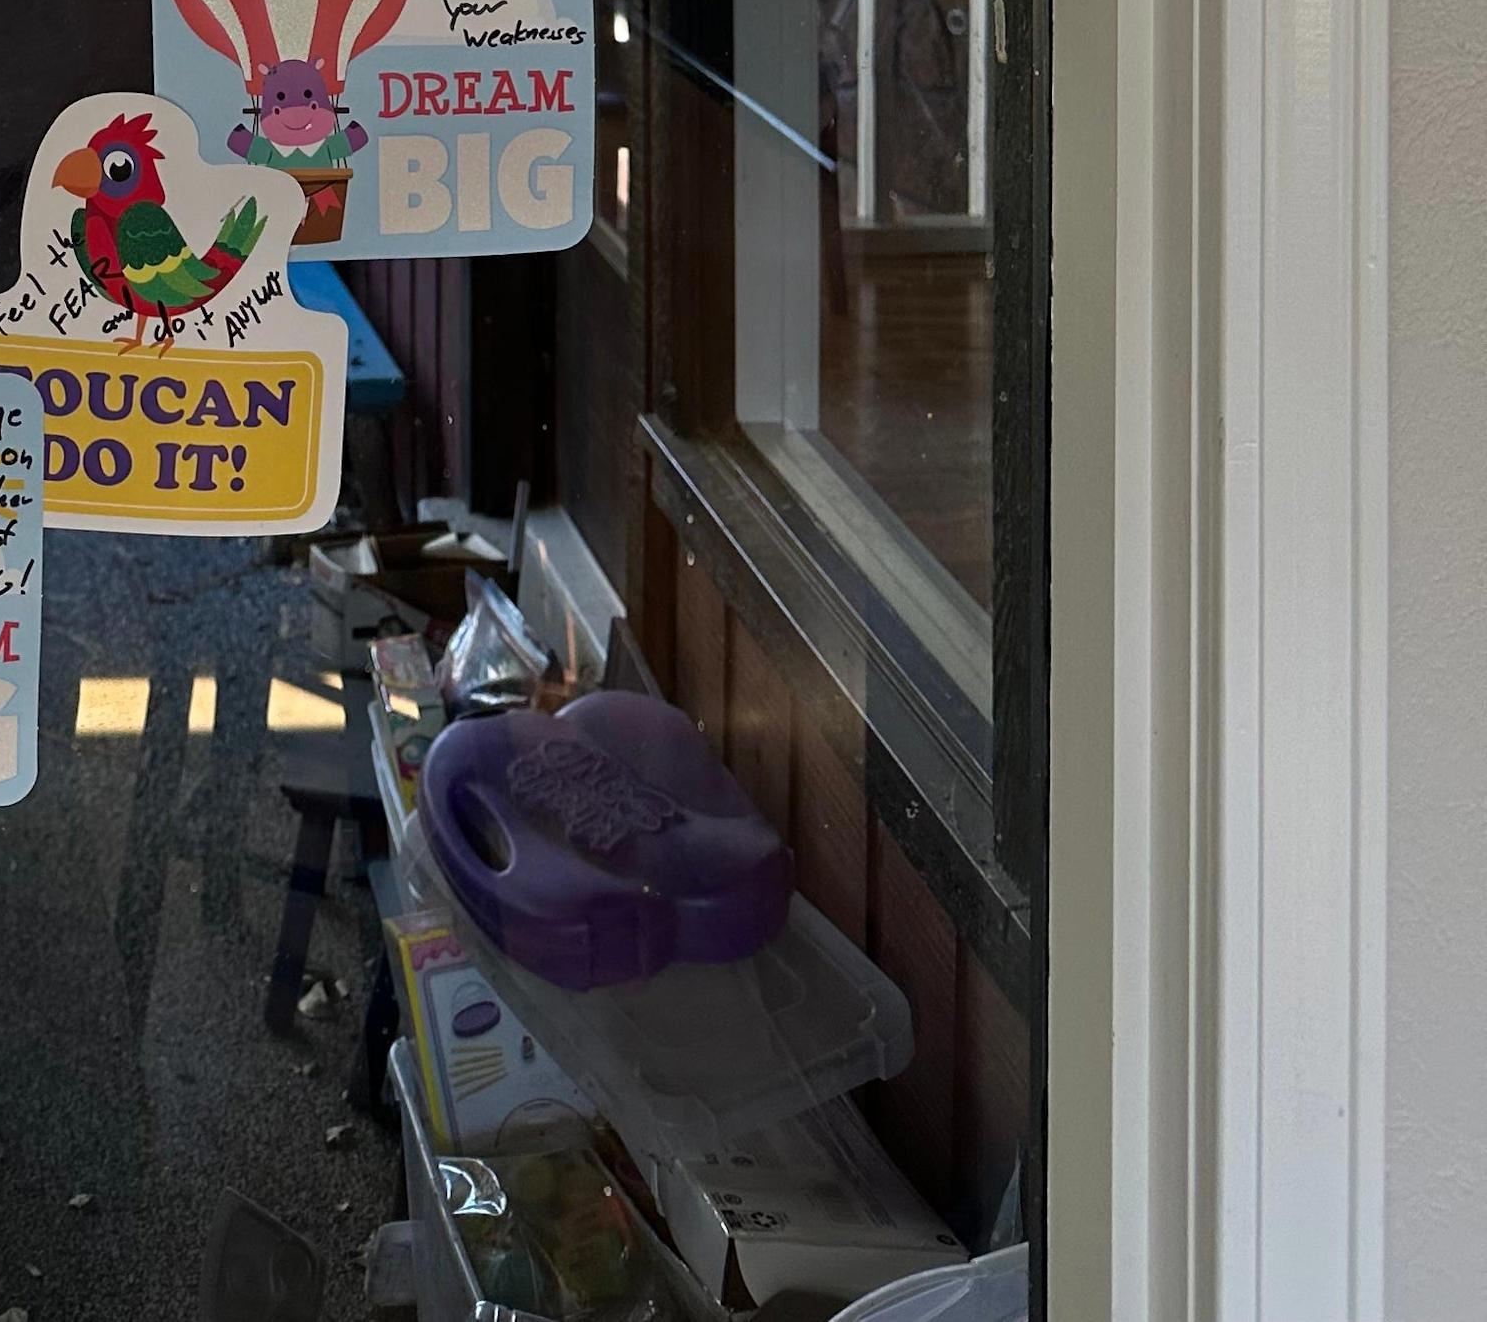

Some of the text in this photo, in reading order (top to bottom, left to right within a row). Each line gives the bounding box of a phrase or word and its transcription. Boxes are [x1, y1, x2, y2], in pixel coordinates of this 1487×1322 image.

[462, 19, 588, 48] weaknesses
[378, 69, 575, 119] DREAM
[378, 127, 575, 236] BIG
[46, 228, 86, 269] the
[48, 256, 126, 336] FEAR
[100, 285, 136, 335] and
[153, 299, 186, 343] do
[224, 270, 284, 349] ANYWAY
[193, 305, 215, 341] it
[0, 445, 34, 470] on
[154, 441, 249, 493] IT!
